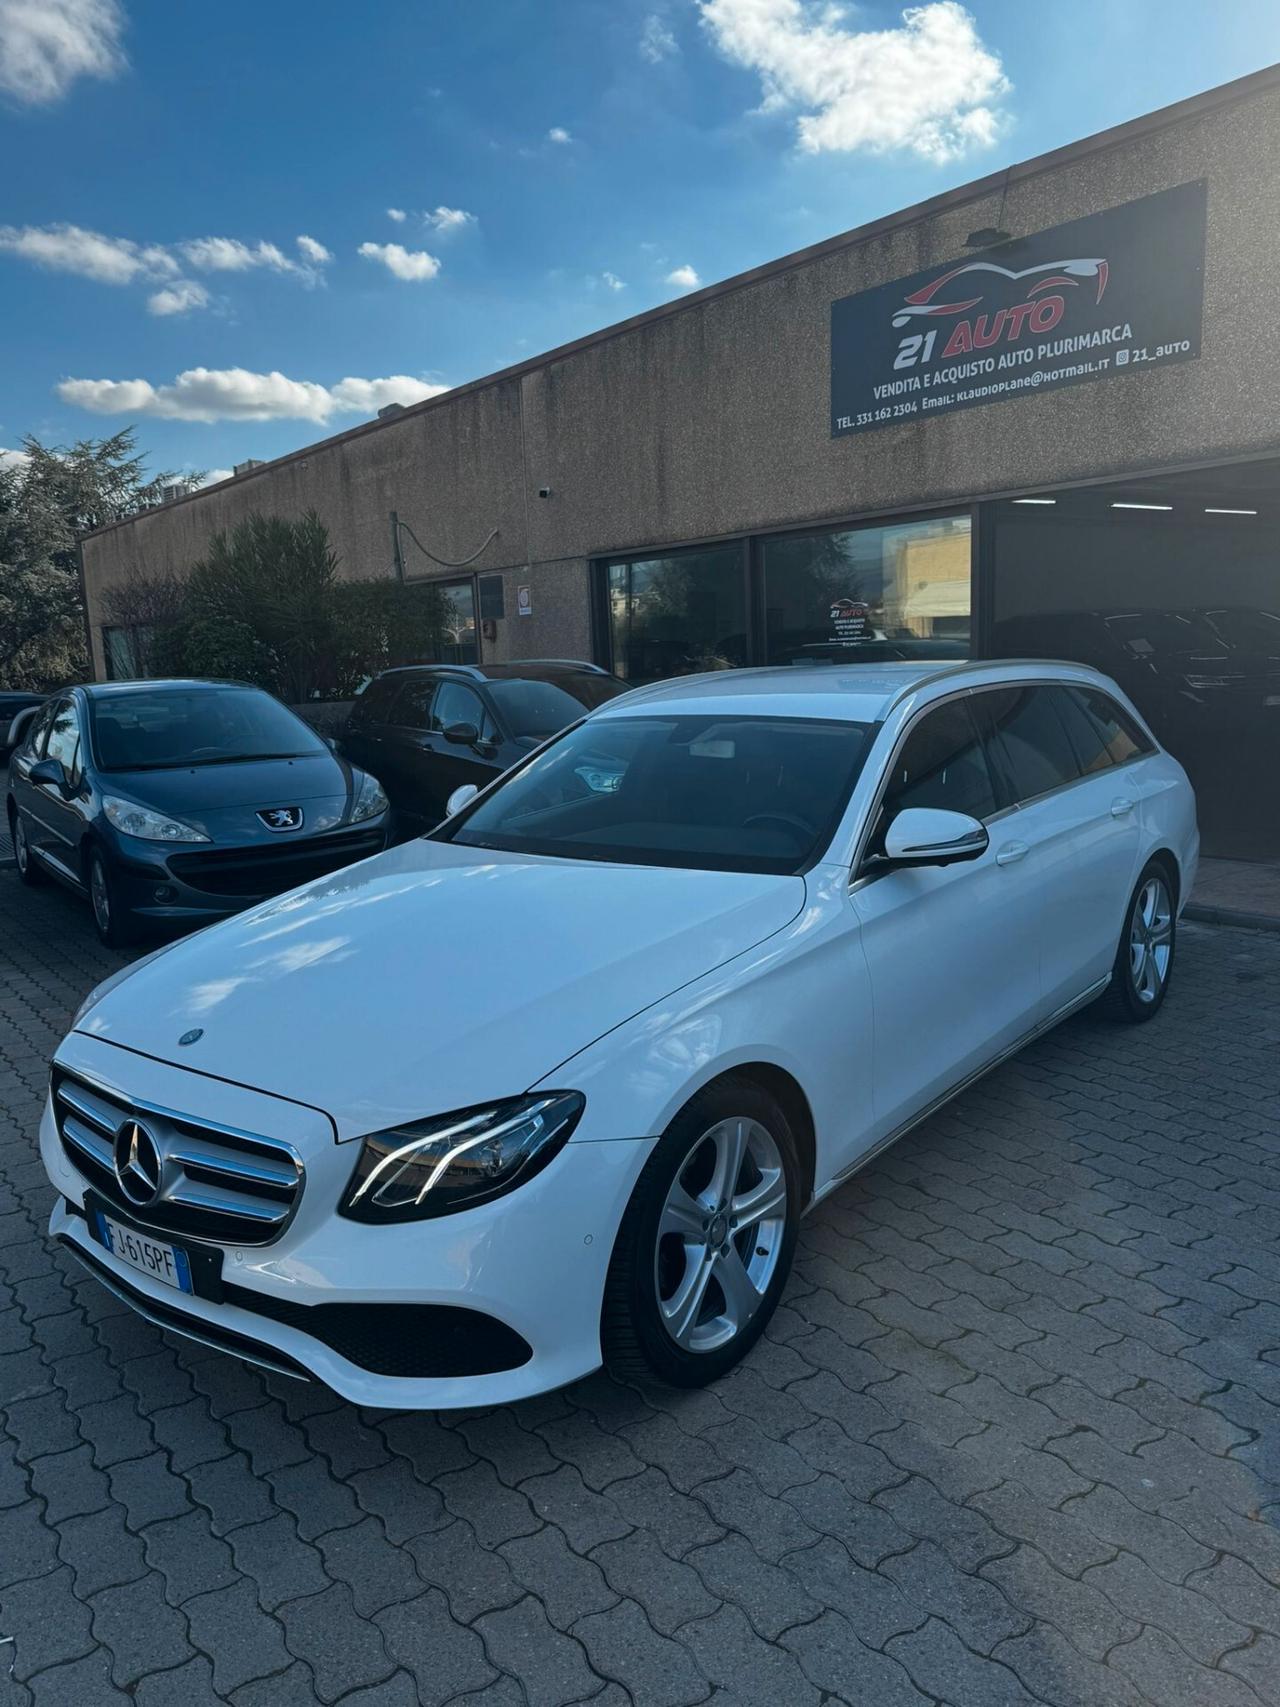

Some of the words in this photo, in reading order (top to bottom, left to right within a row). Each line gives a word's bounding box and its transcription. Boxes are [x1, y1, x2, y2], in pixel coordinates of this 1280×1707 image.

[893, 330, 936, 370] 21
[941, 296, 1065, 359] AUTO
[873, 377, 921, 400] VENDITA
[924, 374, 931, 388] E
[933, 358, 995, 385] ACQUISTO
[998, 348, 1034, 370] AUTO
[1038, 323, 1132, 360] PLURIMARCA
[837, 417, 855, 429] TEL.
[856, 412, 872, 426] 331
[875, 407, 891, 420] 162
[893, 401, 917, 416] 2304
[830, 610, 840, 618] 21
[841, 609, 863, 618] AUTO
[106, 1223, 173, 1277] FJ615PF
